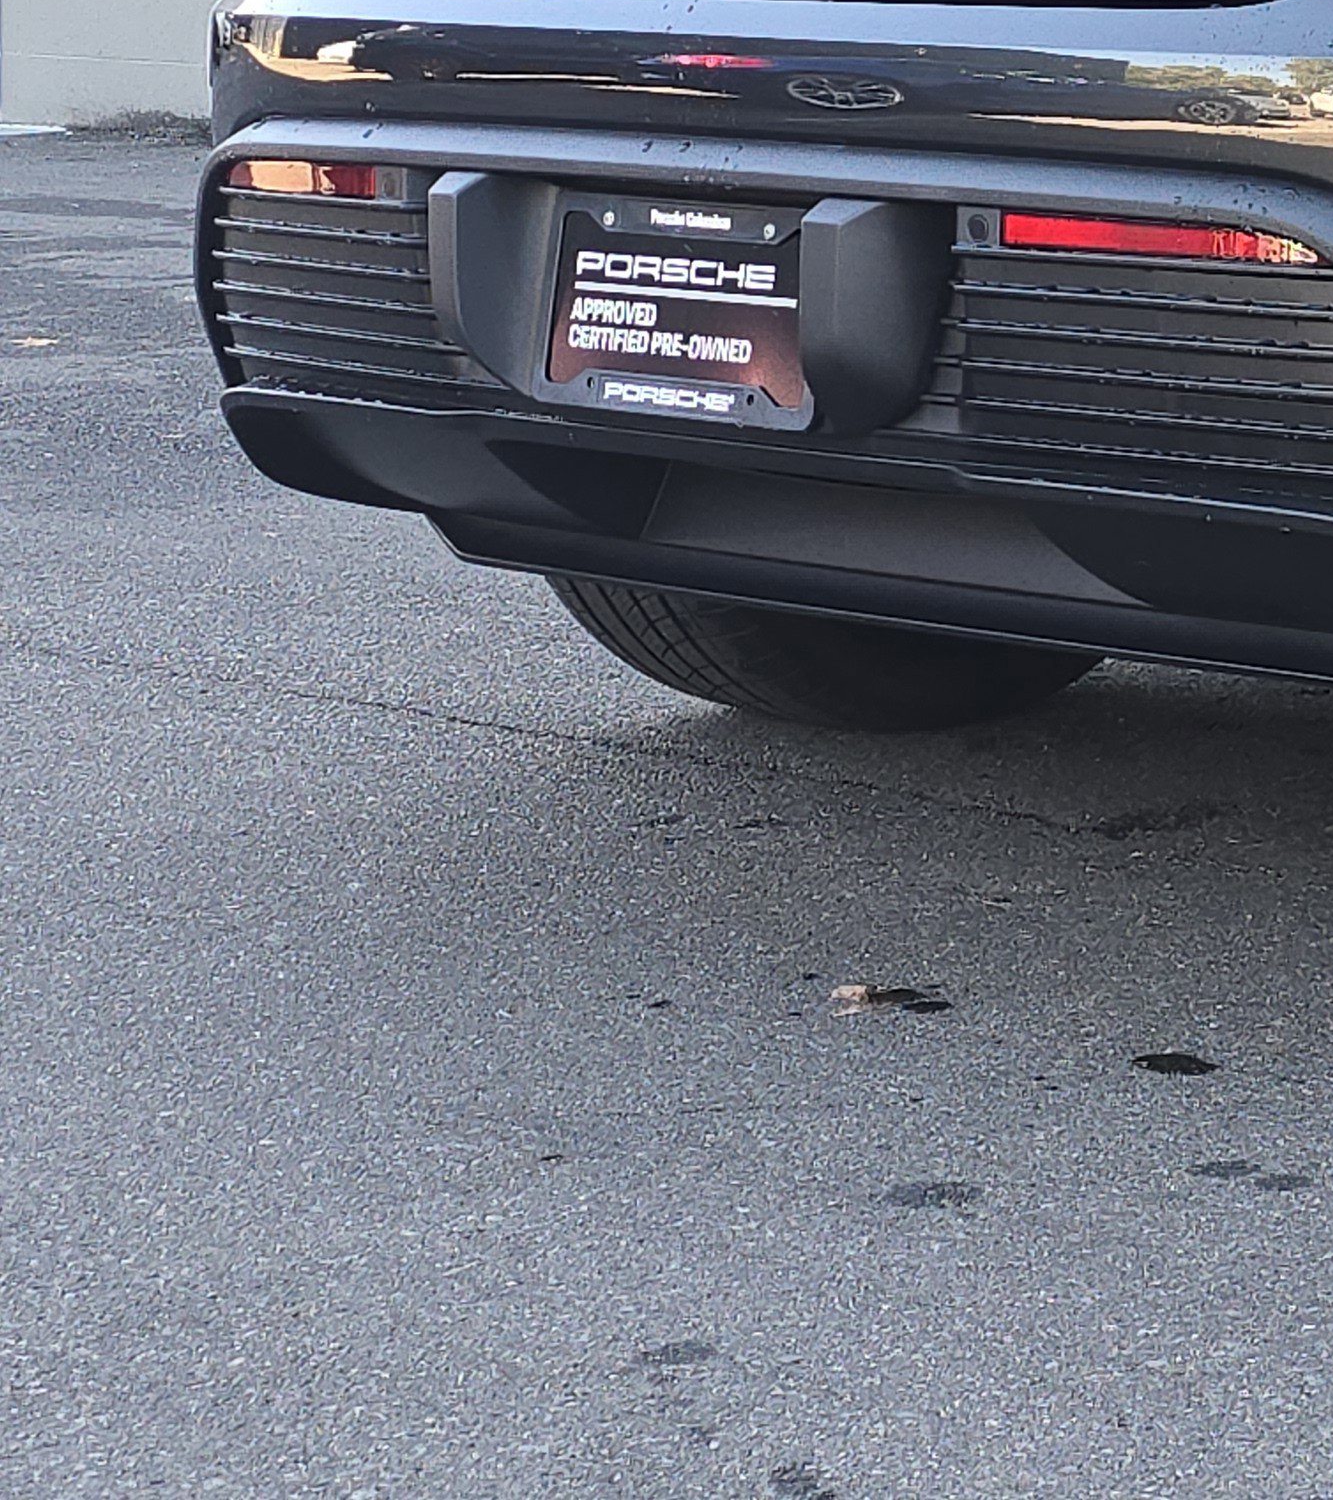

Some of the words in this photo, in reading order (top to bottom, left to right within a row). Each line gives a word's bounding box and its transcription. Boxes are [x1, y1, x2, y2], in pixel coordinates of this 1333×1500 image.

[576, 251, 775, 289] PORSCHE
[569, 297, 657, 326] APPROVED
[568, 325, 649, 353] CERTIFIED
[650, 330, 752, 364] PRE-OWNED
